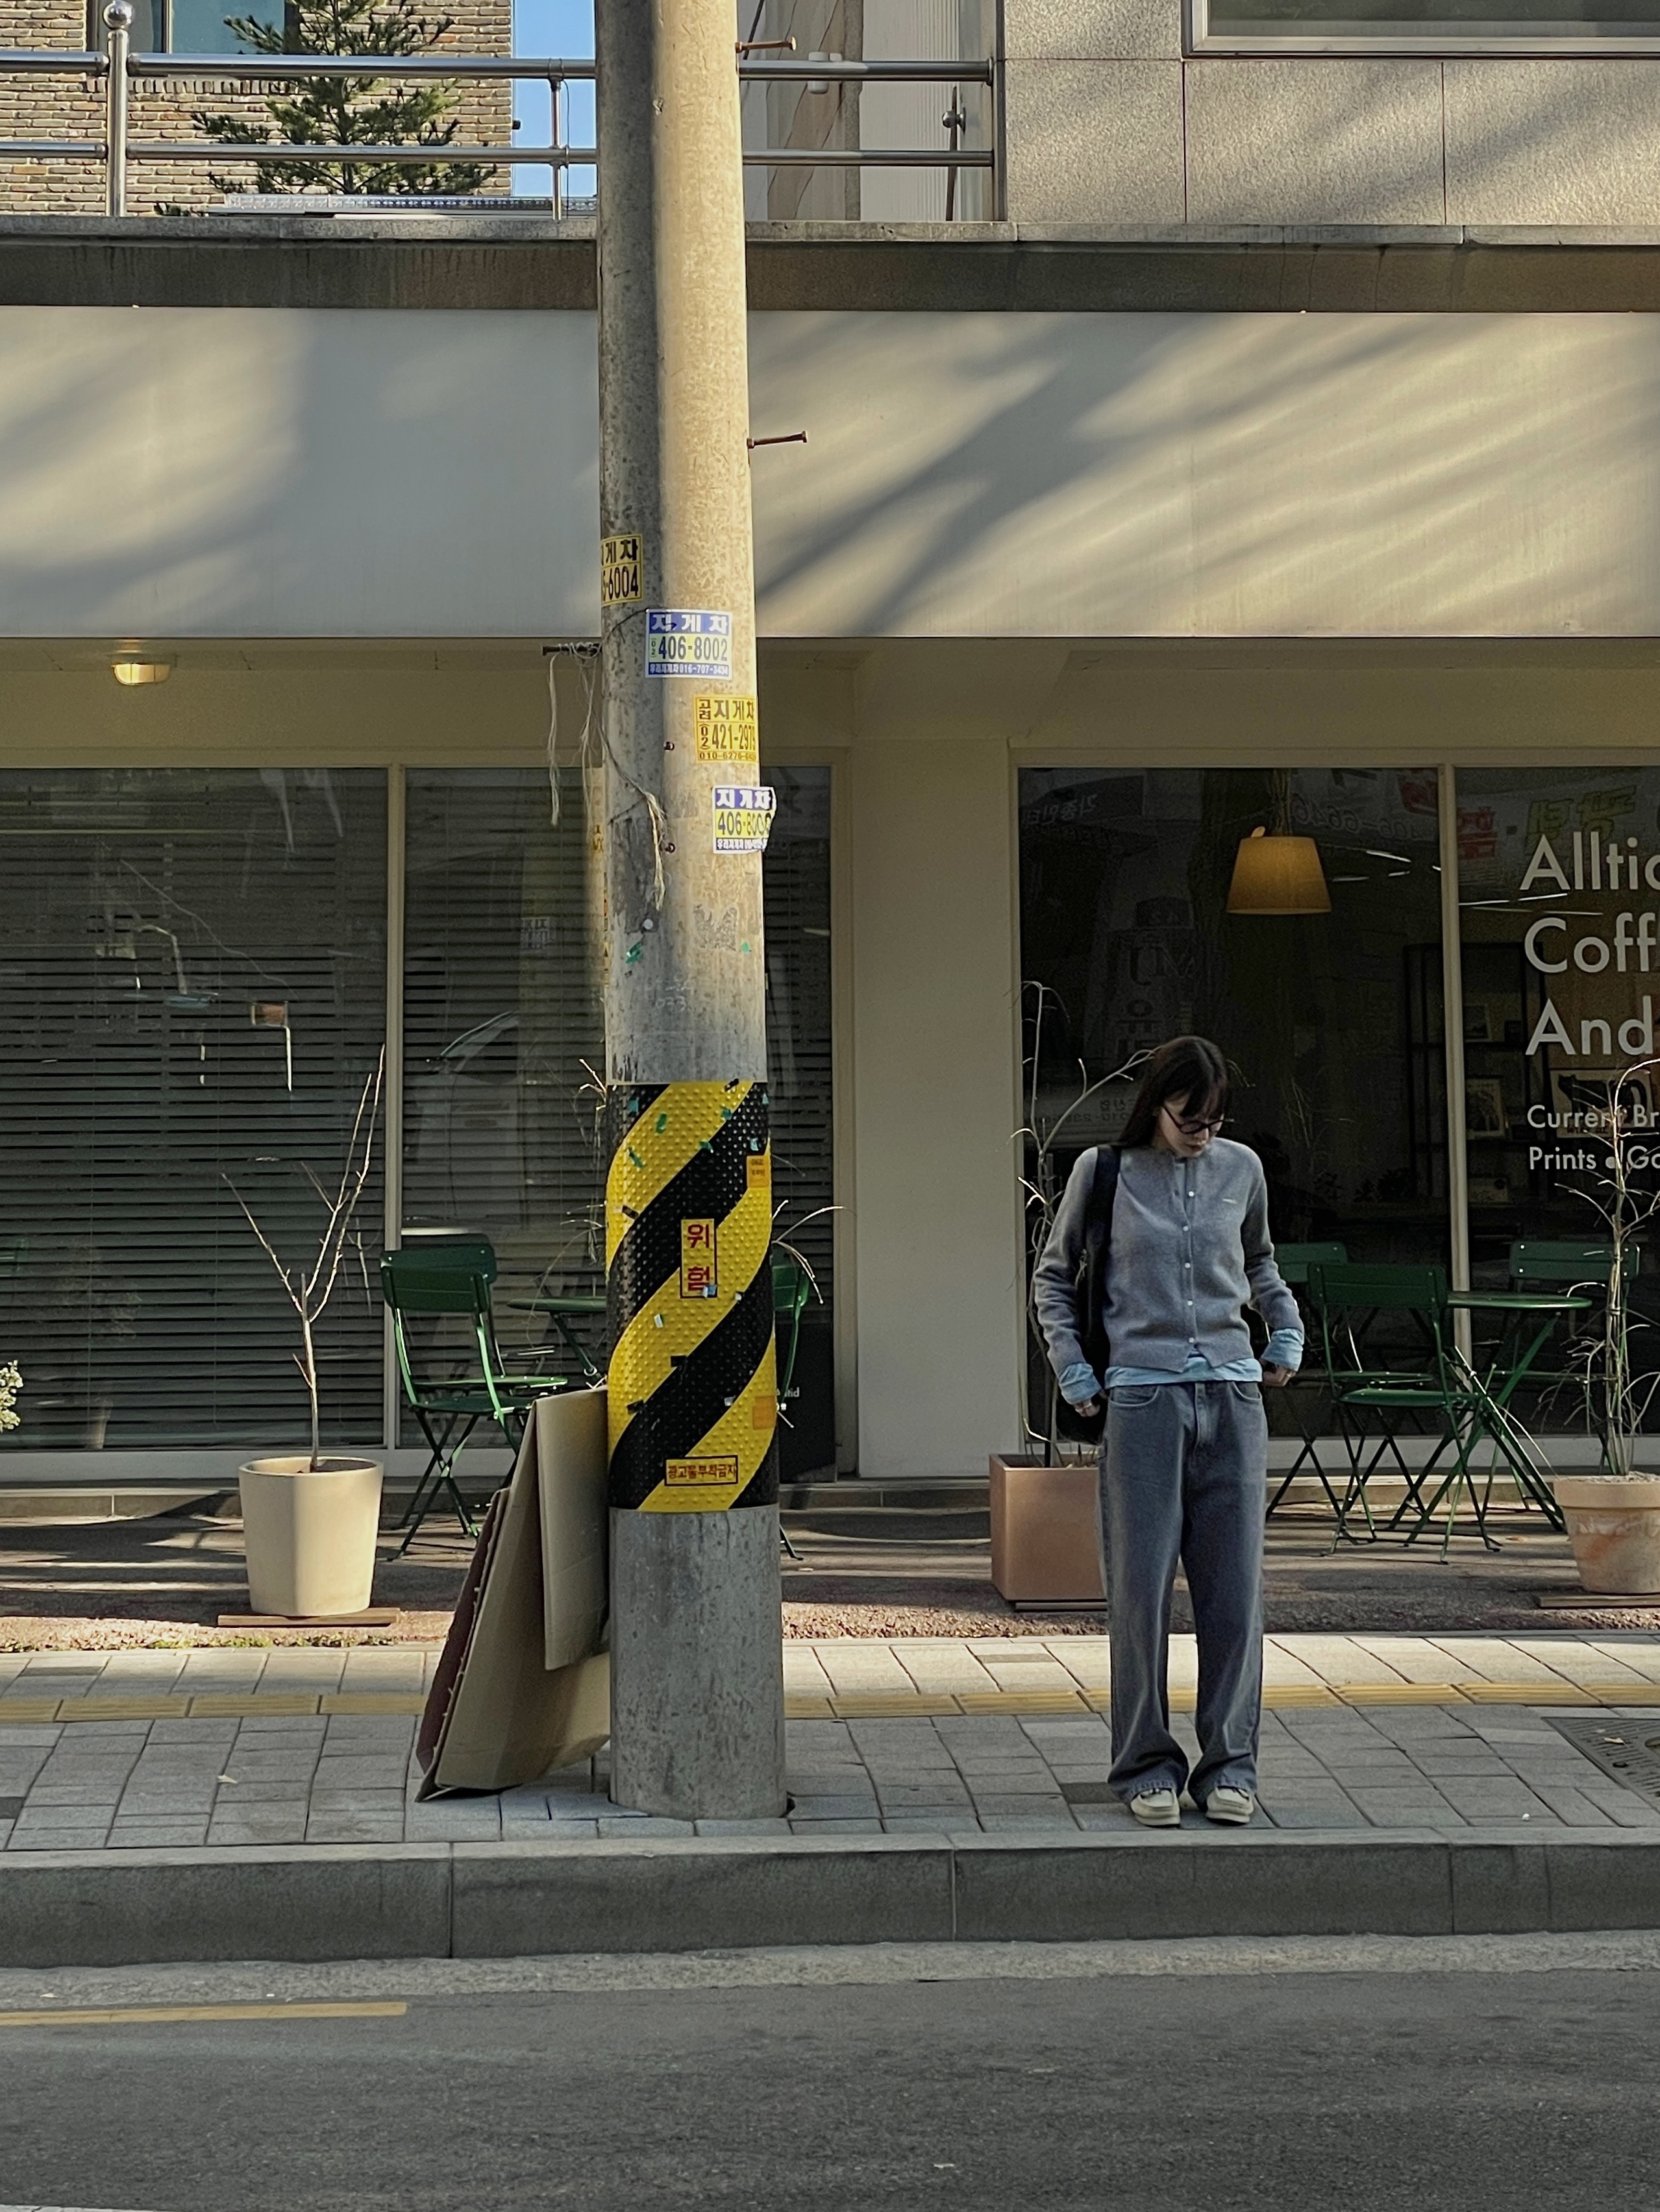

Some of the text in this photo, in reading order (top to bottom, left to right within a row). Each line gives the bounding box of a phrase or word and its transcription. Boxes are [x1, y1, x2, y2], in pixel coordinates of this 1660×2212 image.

[658, 635, 728, 661] 406-8002
[1525, 996, 1653, 1055] And
[1530, 1146, 1596, 1170] Prints
[687, 1224, 710, 1292] 위험
